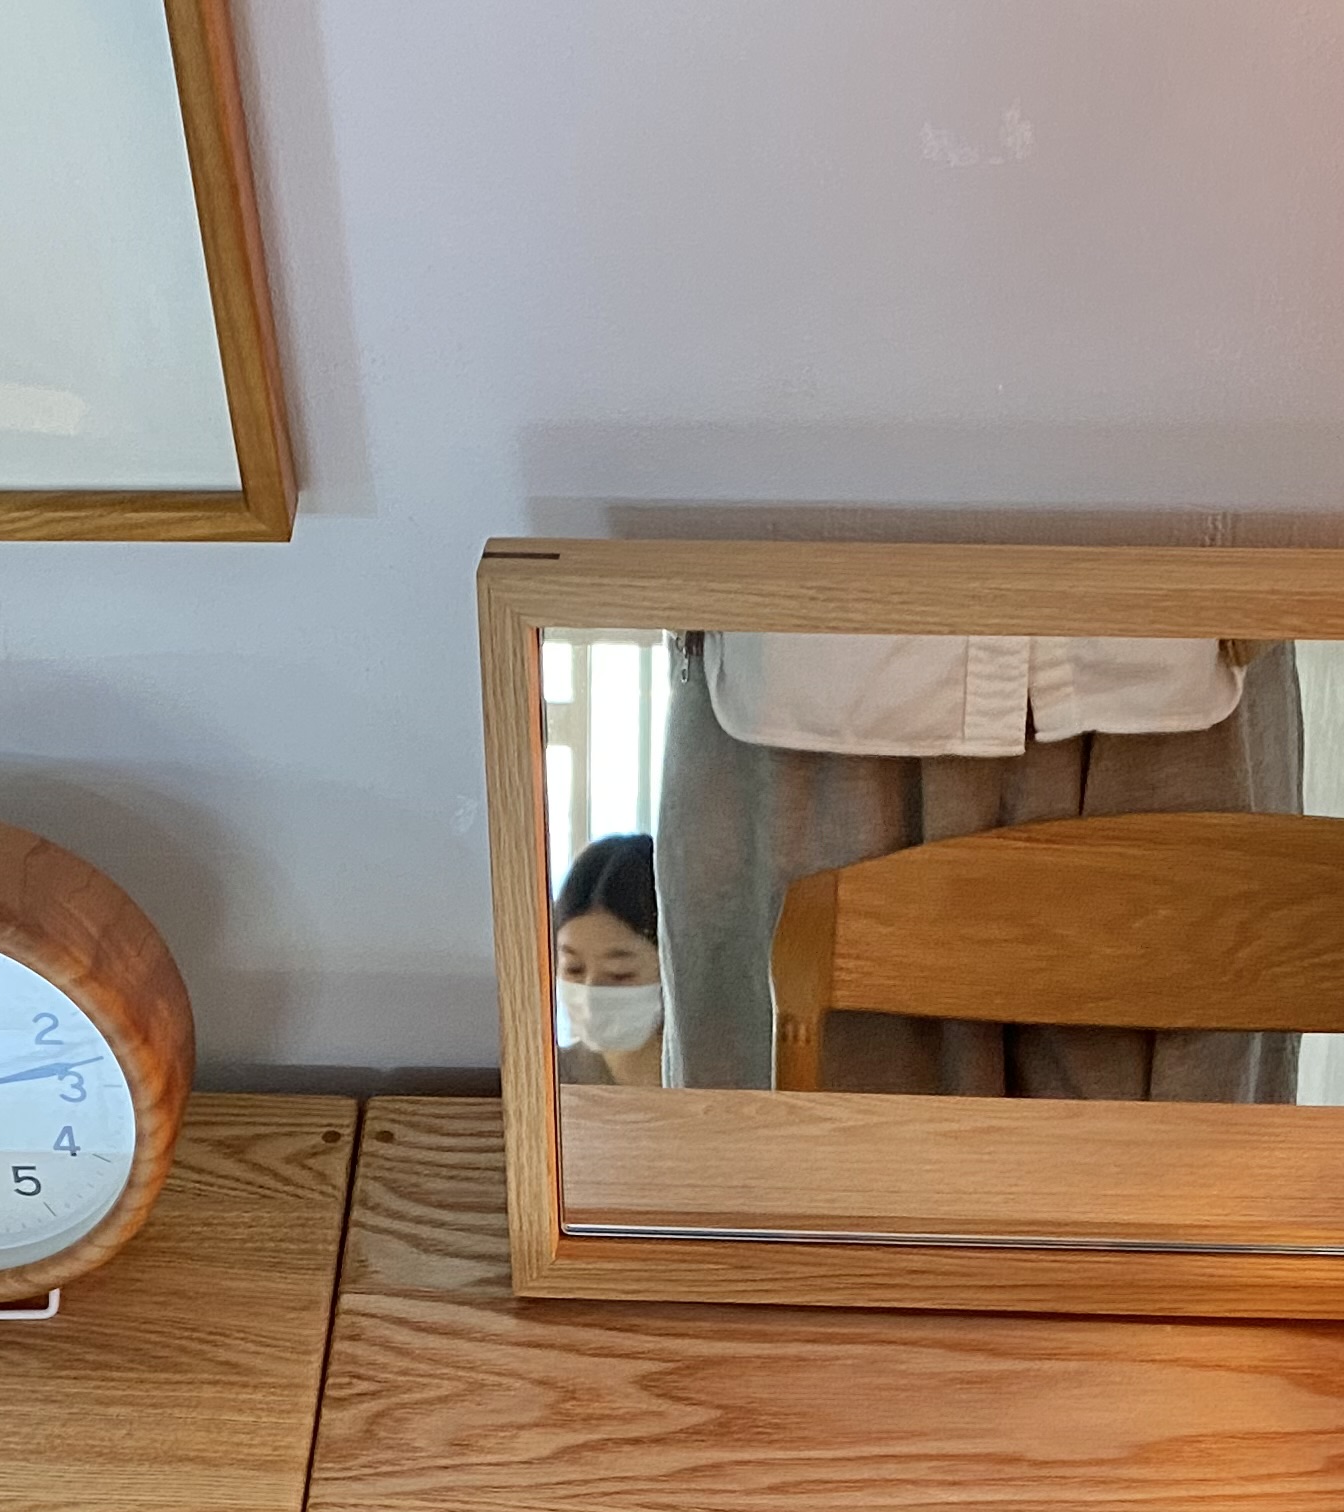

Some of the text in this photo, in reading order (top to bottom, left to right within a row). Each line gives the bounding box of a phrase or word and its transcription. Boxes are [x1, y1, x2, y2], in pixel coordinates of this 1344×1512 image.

[32, 1012, 65, 1045] 2
[58, 1069, 87, 1103] 3
[53, 1125, 82, 1157] 4
[11, 1165, 42, 1196] 5
